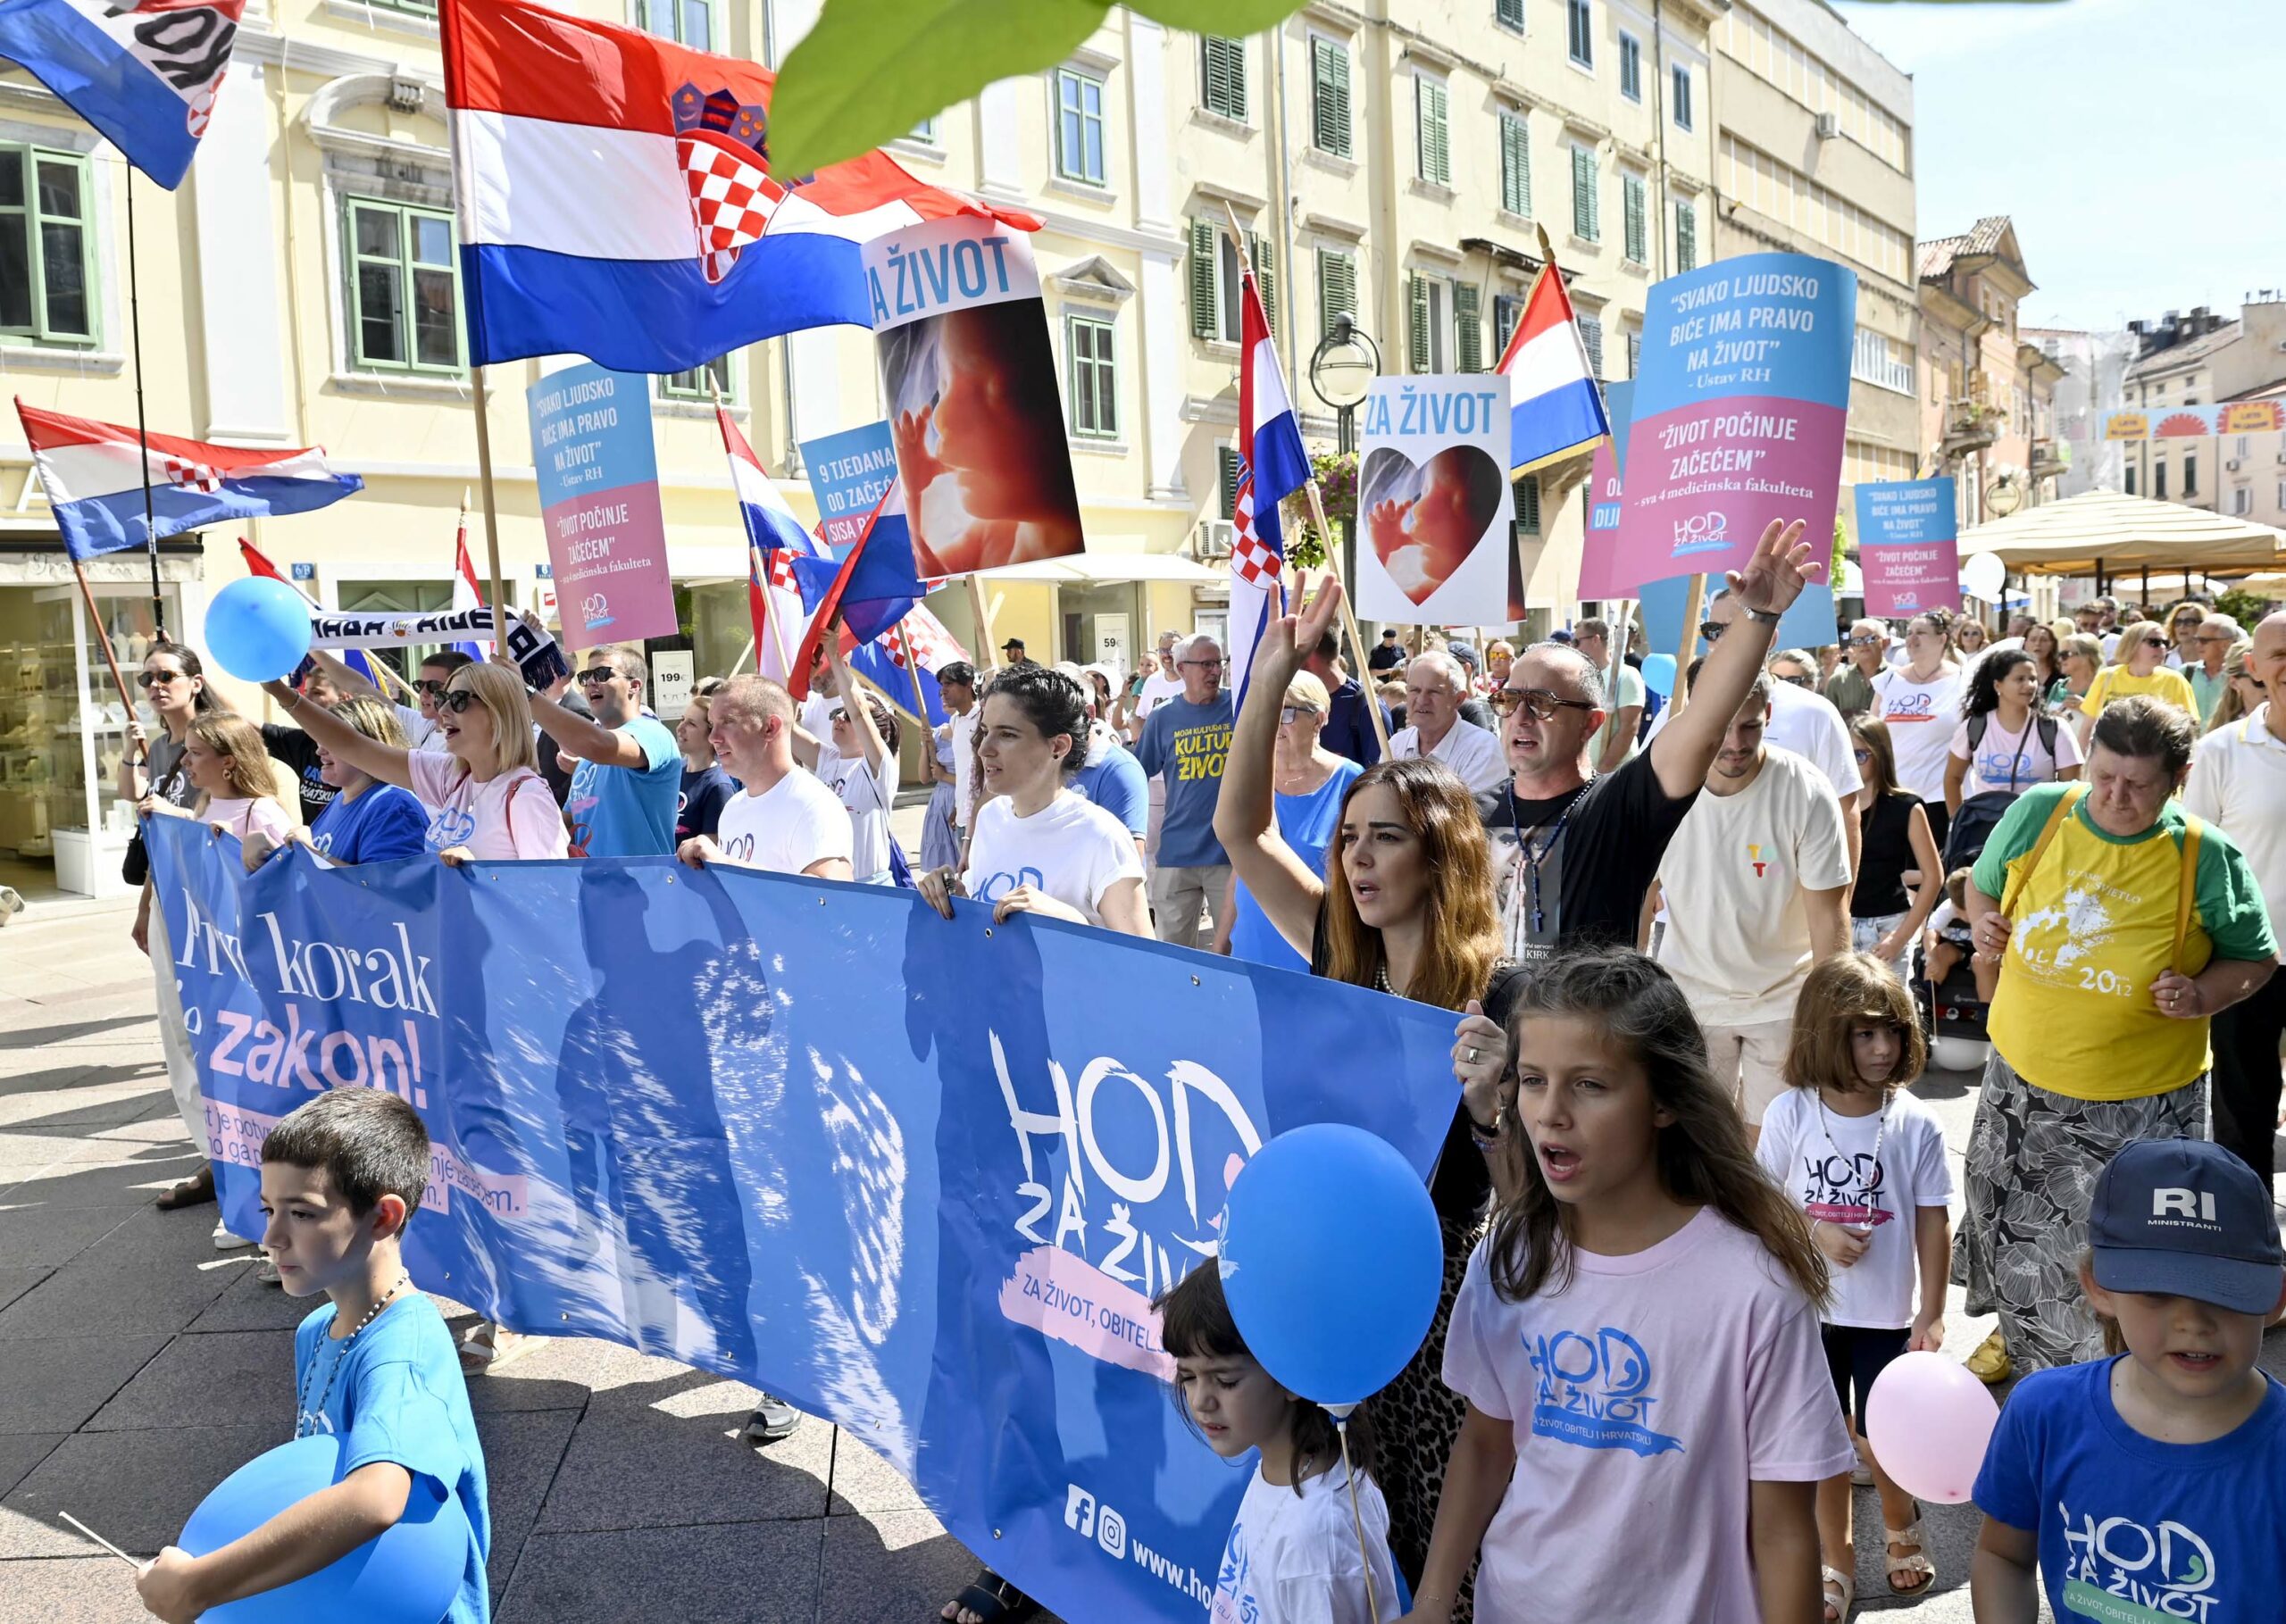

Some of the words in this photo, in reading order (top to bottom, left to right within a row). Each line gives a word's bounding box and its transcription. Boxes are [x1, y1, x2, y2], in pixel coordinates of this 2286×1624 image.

[868, 266, 890, 324] A
[887, 237, 1009, 316] ŽIVOT
[1733, 274, 1819, 300] LJUDSKO
[1670, 316, 1704, 346] BIĆE
[1708, 311, 1741, 336] IMA
[1748, 307, 1814, 332] PRAVO
[1687, 349, 1708, 372] NA
[563, 377, 614, 407] LJUDSKO
[1697, 371, 1738, 389] Ustav
[1740, 368, 1771, 383] RH
[557, 418, 576, 439] IMA
[578, 407, 618, 434] PRAVO
[1365, 395, 1391, 435] ZA
[1399, 385, 1497, 435] ŽIVOT
[1713, 411, 1798, 441] POČINJE
[555, 453, 565, 472] NA
[819, 464, 829, 484] 9
[829, 447, 896, 481] TJEDANA
[563, 474, 584, 487] Ustav
[585, 466, 604, 481] RH
[827, 491, 846, 512] OD
[1640, 495, 1656, 507] sva
[1658, 489, 1665, 501] 4
[1667, 479, 1741, 498] medicinska
[1745, 478, 1814, 499] fakulteta
[580, 504, 630, 531] POČINJE
[829, 520, 856, 542] SISA
[1673, 512, 1727, 539] HOD
[1673, 536, 1689, 546] ZA
[609, 557, 652, 573] fakulteta
[580, 593, 607, 612] HOD
[1889, 693, 1931, 710] HOD
[1173, 729, 1192, 738] MOJA
[1193, 724, 1222, 735] KULTURA
[1222, 722, 1231, 730] JE
[1177, 753, 1228, 781] ŽIVO
[1979, 752, 2032, 770] HOD
[256, 912, 439, 1019] korak
[1526, 950, 1550, 960] KIRK
[209, 1004, 427, 1109] zakon!
[215, 1105, 231, 1134] je
[989, 1027, 1263, 1237] HOD
[229, 1142, 251, 1164] ga
[1804, 1153, 1883, 1191] HOD
[1804, 1186, 1823, 1203] ZA
[1828, 1188, 1885, 1208] ŽIVOT
[2153, 1187, 2215, 1221] RI
[1014, 1171, 1088, 1261] ZA
[1098, 1203, 1189, 1298] ŽIV
[2148, 1220, 2222, 1232] MINISTRANTI
[1022, 1274, 1040, 1301] ZA
[1043, 1278, 1096, 1328] ŽIVOT,
[1521, 1327, 1650, 1397] HOD
[1565, 1384, 1658, 1428] ŽIVOT
[1564, 1423, 1594, 1438] OBITELJ
[1601, 1432, 1652, 1446] HRVATSKU
[2058, 1500, 2215, 1593] HOD
[2065, 1555, 2099, 1586] ZA
[2106, 1568, 2220, 1624] ŽIVOT
[2077, 1593, 2105, 1615] ŽIVOT,
